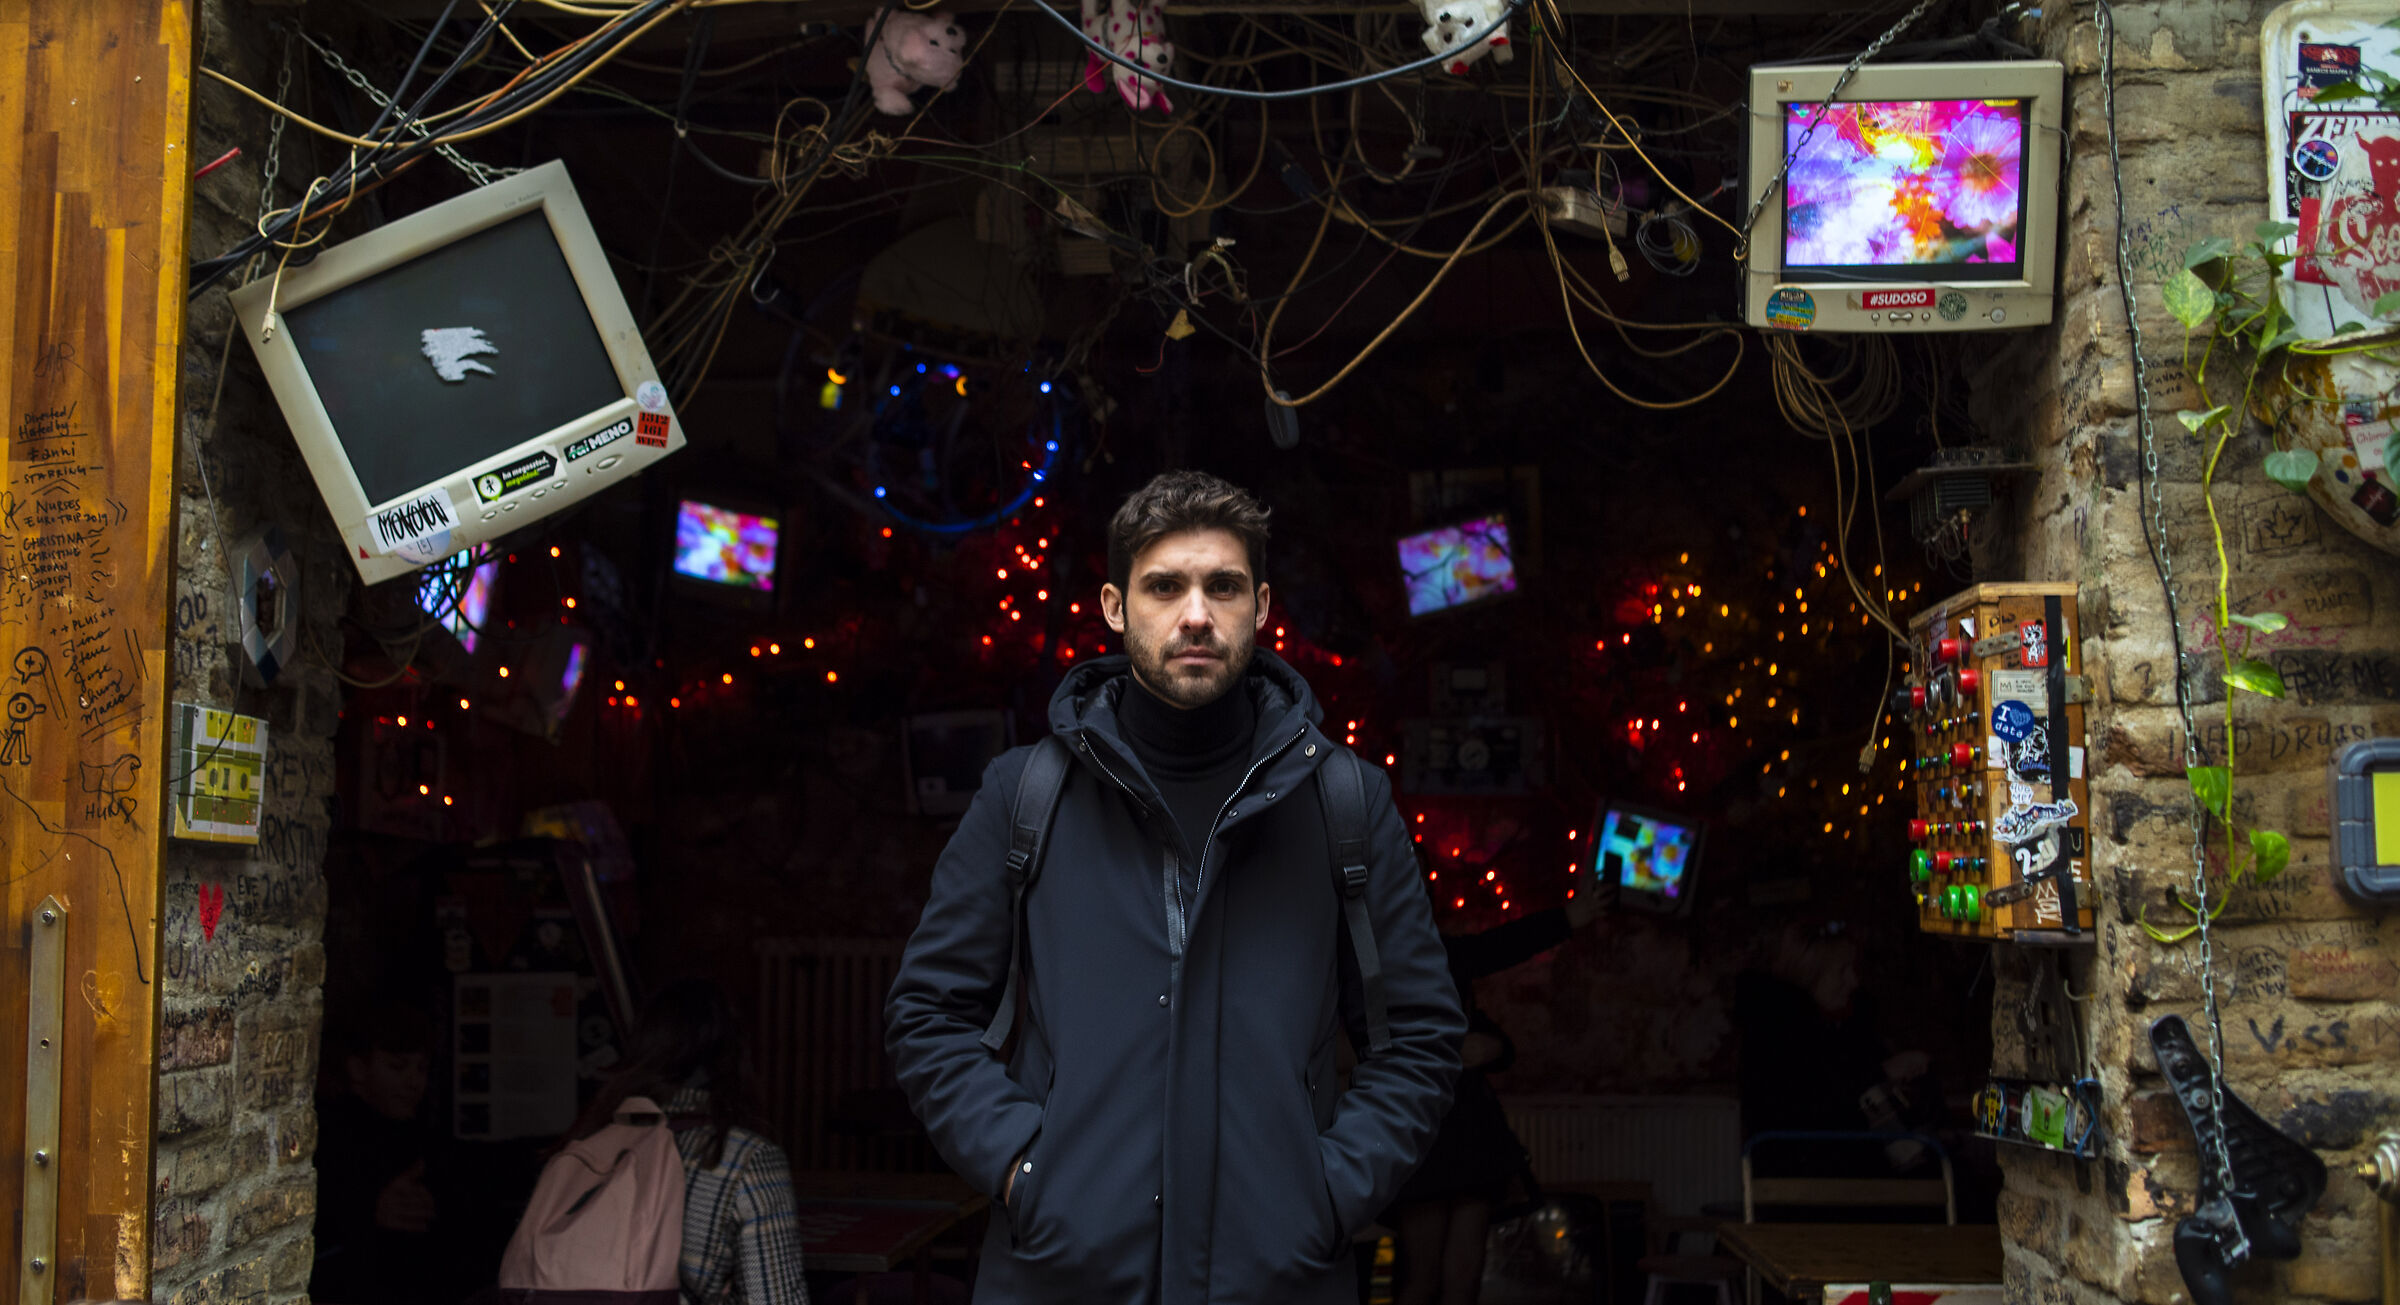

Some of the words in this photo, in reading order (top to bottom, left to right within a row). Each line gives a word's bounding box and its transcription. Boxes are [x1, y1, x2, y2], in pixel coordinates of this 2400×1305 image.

[1870, 292, 1927, 306] #SUDOSO
[640, 412, 669, 425] 1312
[36, 500, 81, 513] NURSES
[23, 532, 84, 551] CHRISTINA
[1997, 704, 2011, 722] I
[1995, 722, 2023, 739] data
